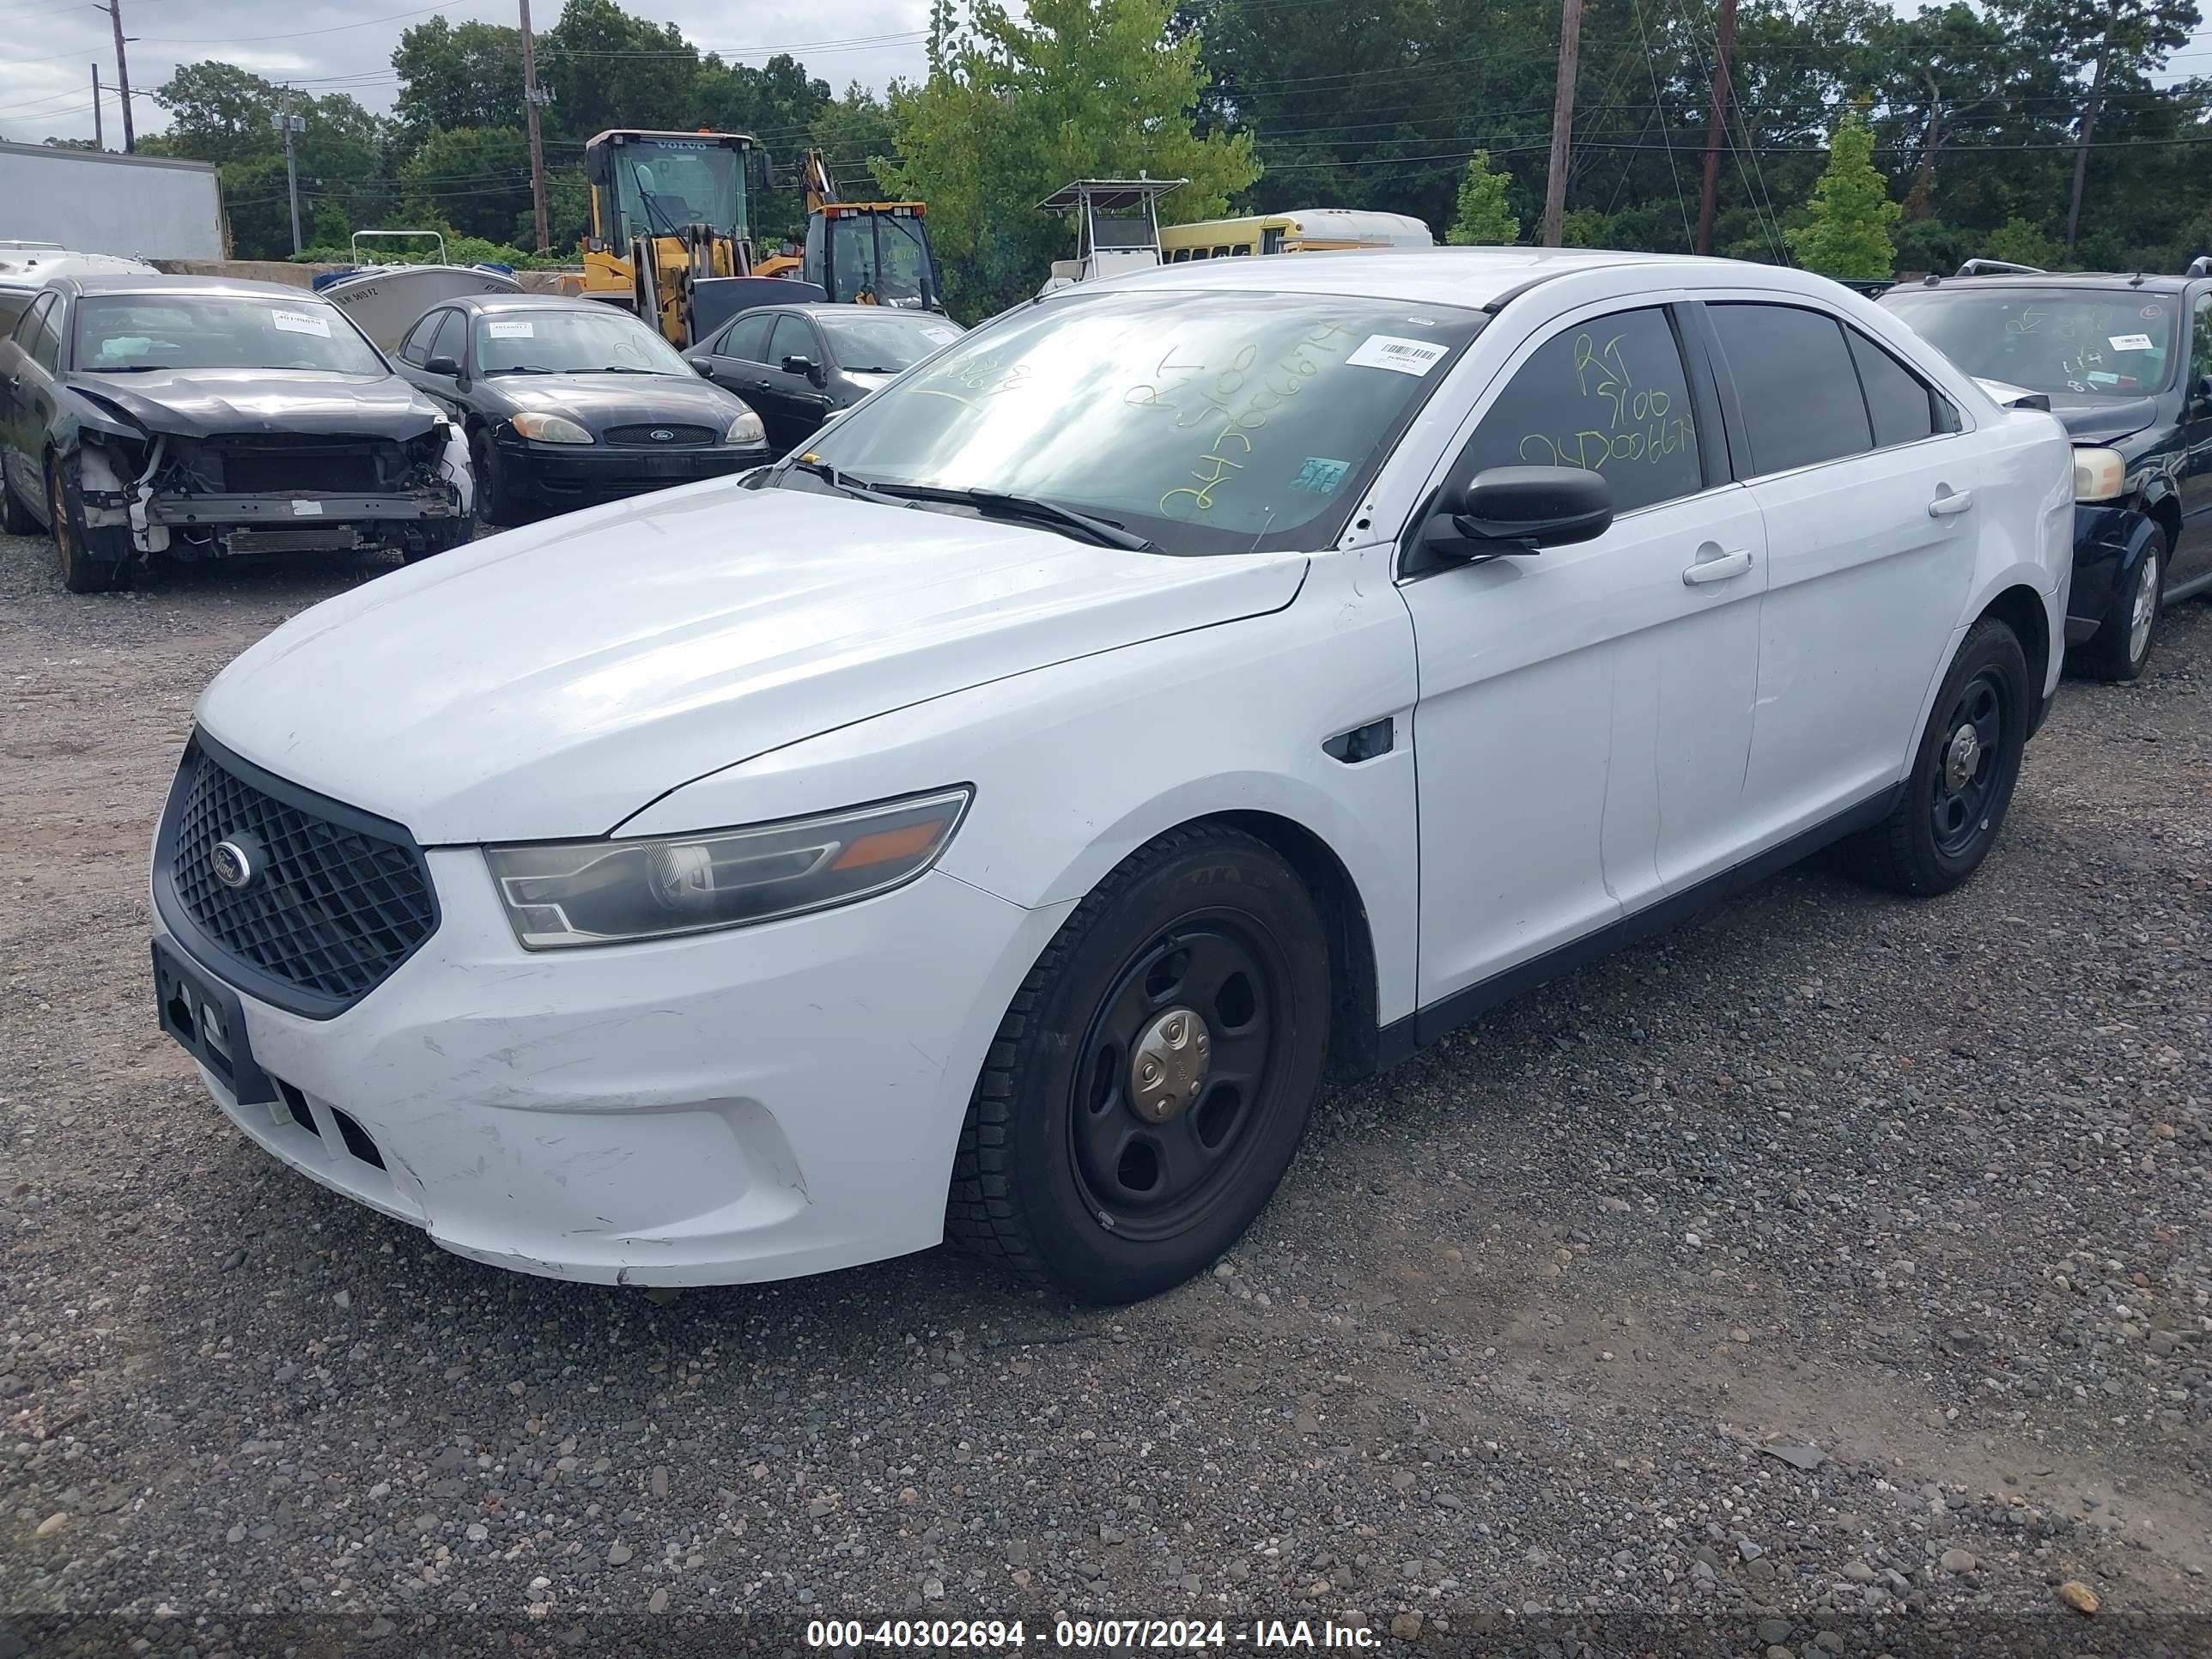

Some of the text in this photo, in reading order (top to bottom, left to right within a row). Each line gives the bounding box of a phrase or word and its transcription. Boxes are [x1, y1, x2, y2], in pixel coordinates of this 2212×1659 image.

[656, 141, 707, 150] VOLVO
[1124, 344, 1206, 410] RT
[1574, 333, 1632, 396] RT
[216, 850, 235, 879] Ford
